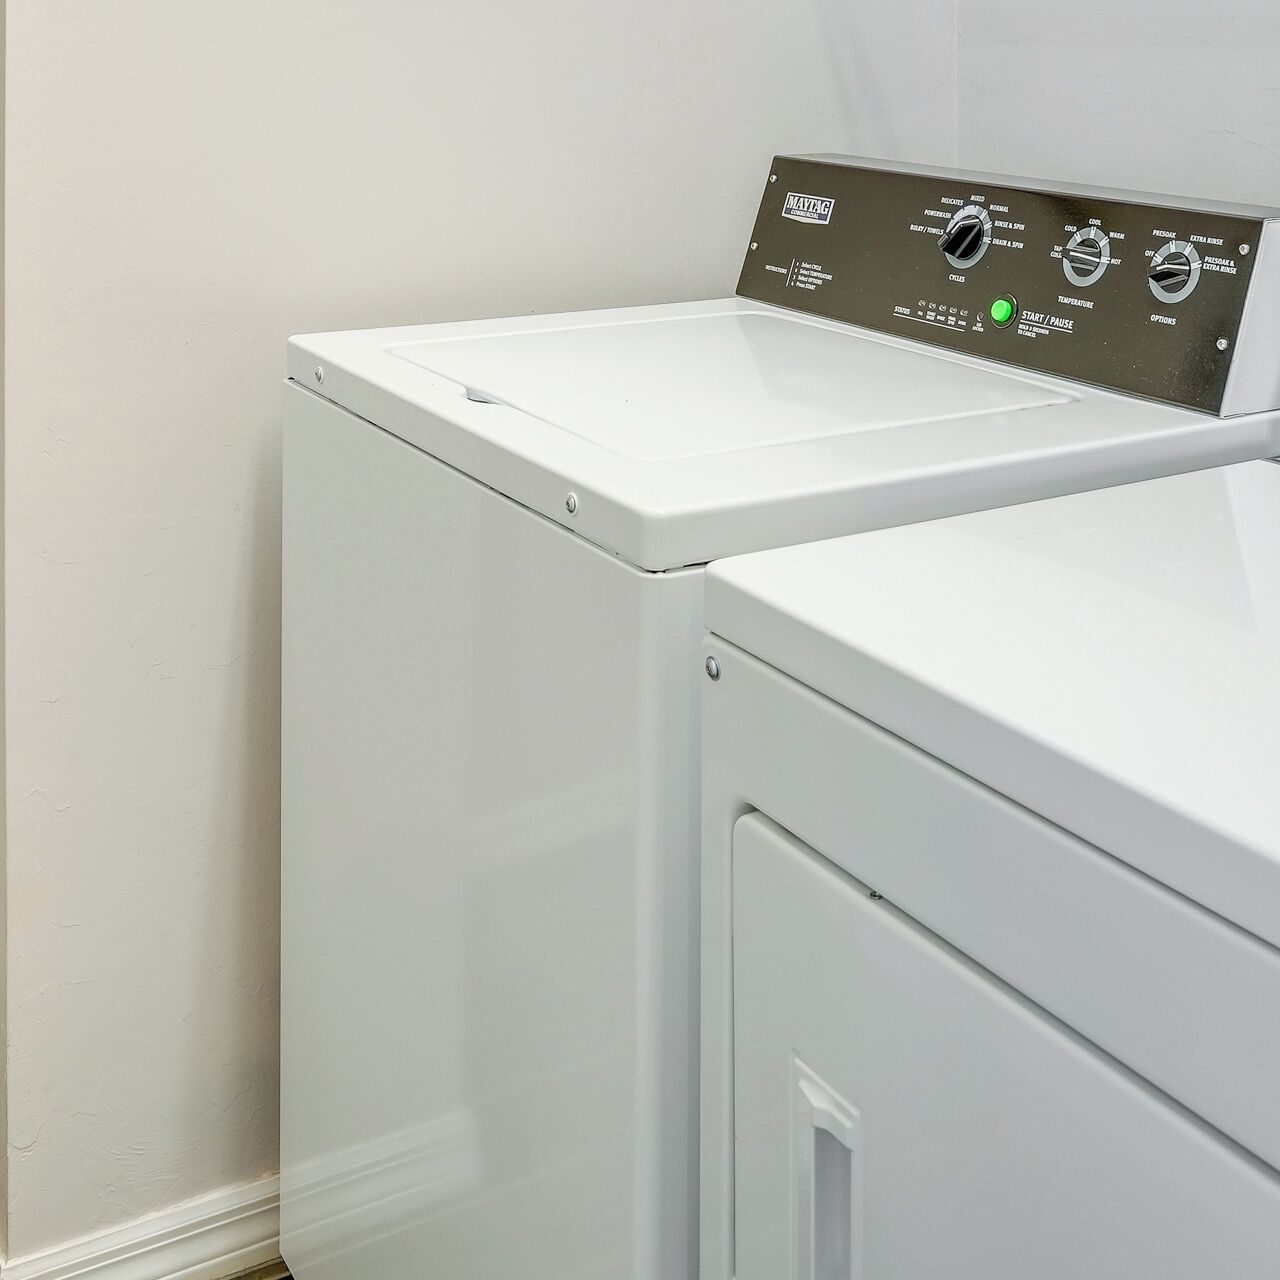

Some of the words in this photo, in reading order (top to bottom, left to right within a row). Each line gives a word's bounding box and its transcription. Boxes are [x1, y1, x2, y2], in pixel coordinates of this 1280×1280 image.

[787, 196, 830, 214] MAYTAG
[941, 197, 964, 206] DELICATES
[989, 204, 1009, 213] NORMAL
[1089, 218, 1101, 226] COOL
[1109, 232, 1125, 240] WARM
[1152, 229, 1176, 238] PRESOAK
[1190, 235, 1207, 243] EXTRA
[1207, 237, 1223, 246] RINSE
[1204, 256, 1229, 266] PRESOAK
[1203, 263, 1219, 271] EXTRA
[949, 274, 966, 283] CYCLES
[1058, 295, 1094, 309] TEMPERATURE
[894, 306, 911, 315] STATUS
[1021, 310, 1044, 322] START
[1044, 315, 1050, 325] /
[1050, 316, 1074, 329] PAUSE
[1150, 314, 1176, 326] OPTIONS
